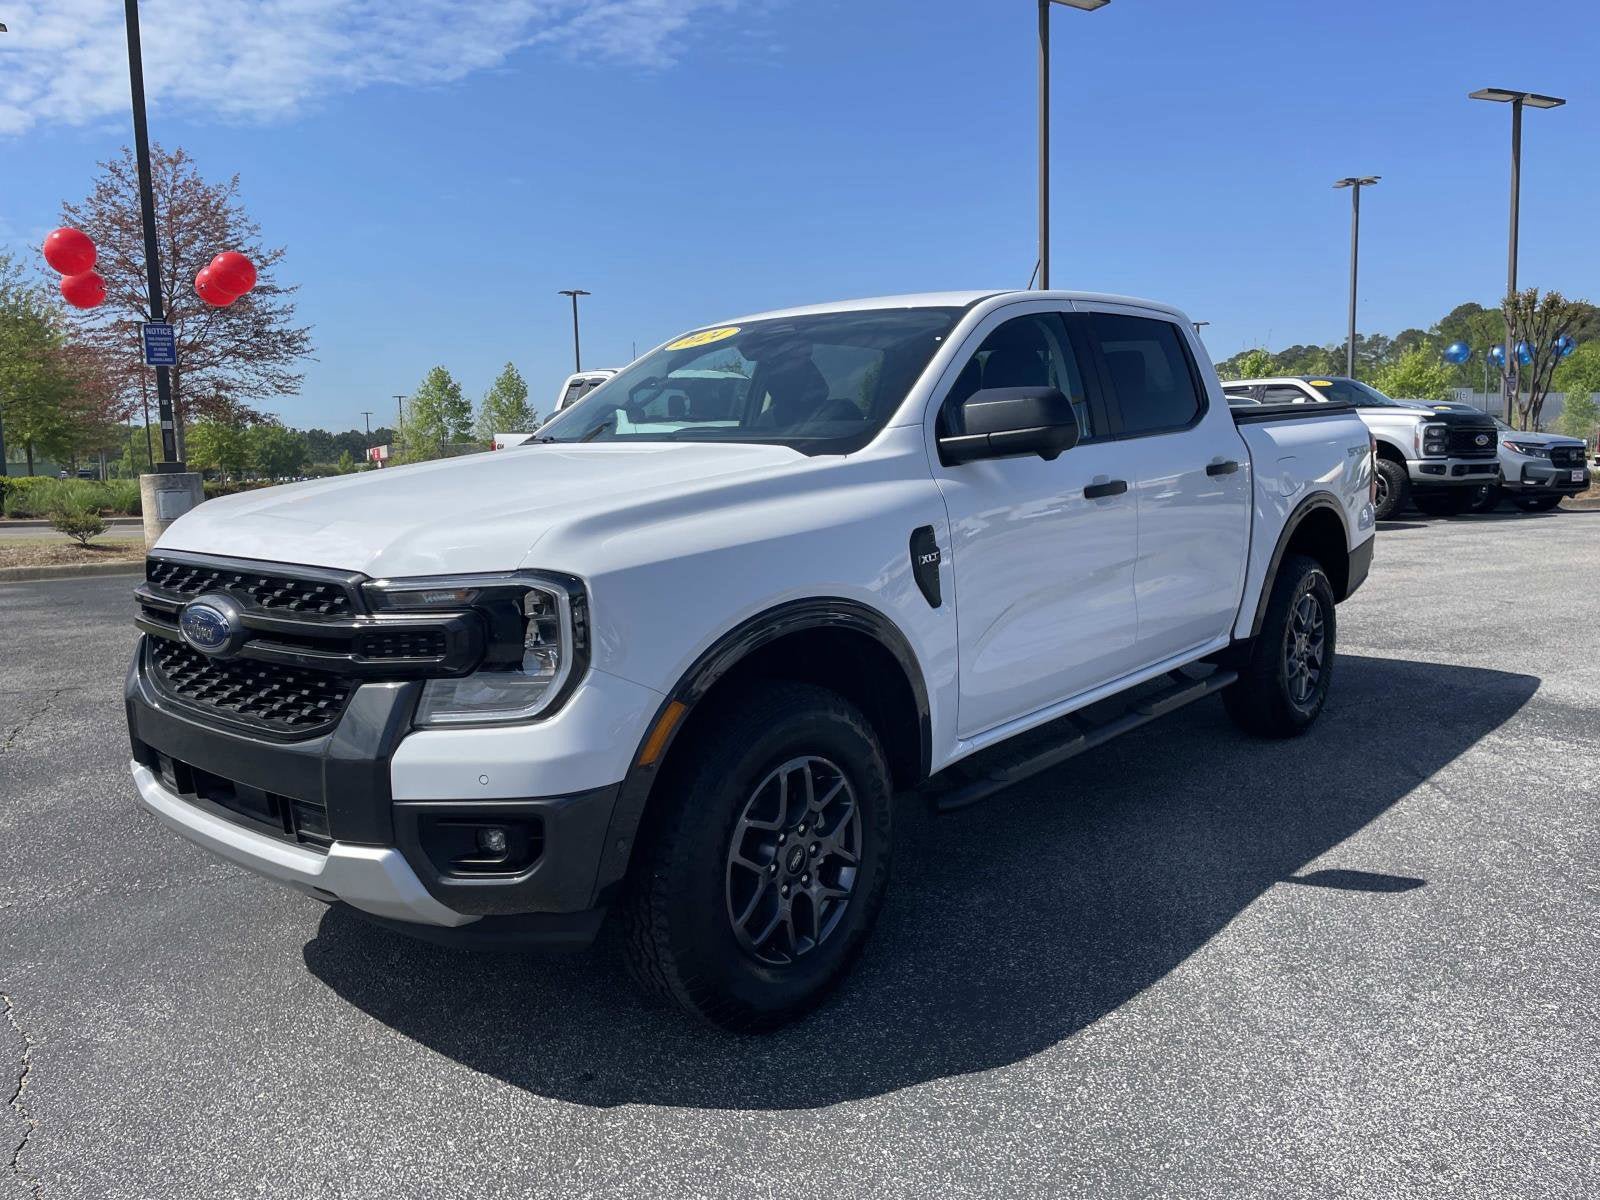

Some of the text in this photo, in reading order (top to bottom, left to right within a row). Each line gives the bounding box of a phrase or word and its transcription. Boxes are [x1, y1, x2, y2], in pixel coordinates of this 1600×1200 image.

[146, 327, 172, 336] NOTICE
[921, 551, 940, 565] XLT
[183, 614, 214, 642] Ford
